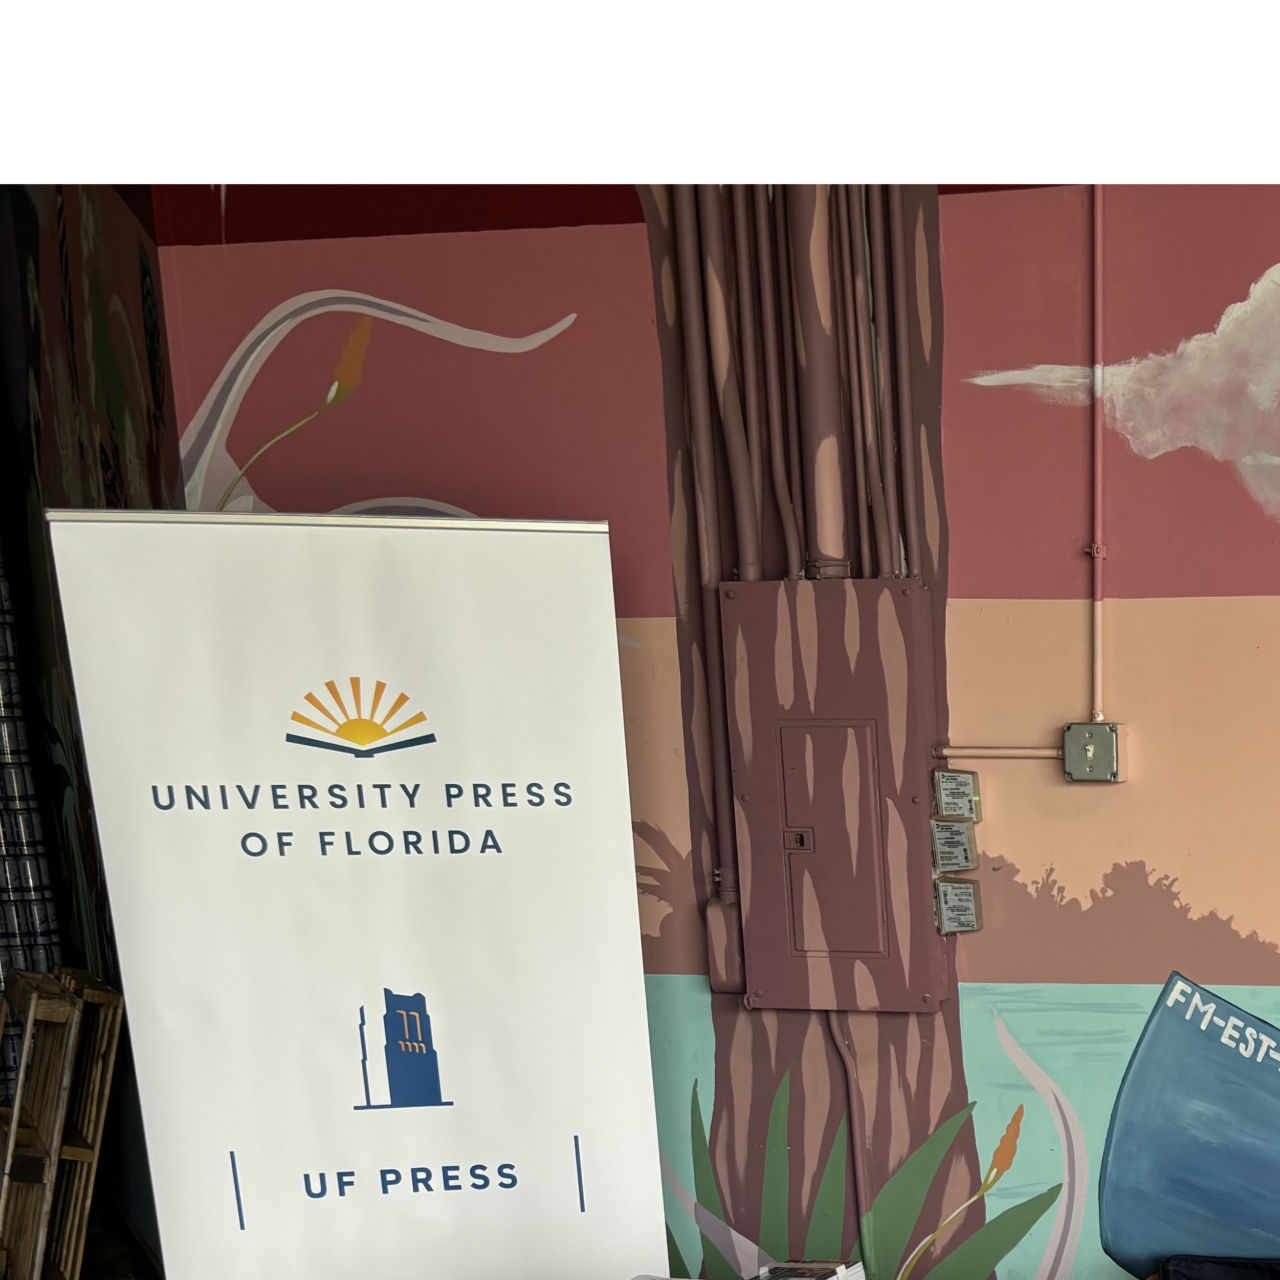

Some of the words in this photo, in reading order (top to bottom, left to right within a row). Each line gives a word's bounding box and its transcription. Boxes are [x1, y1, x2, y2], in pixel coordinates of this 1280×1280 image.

[151, 783, 422, 811] UNIVERSITY
[444, 781, 574, 808] PRESS
[240, 831, 295, 857] OF
[319, 829, 504, 856] FLORIDA
[303, 1171, 355, 1199] UF
[379, 1163, 519, 1195] PRESS
